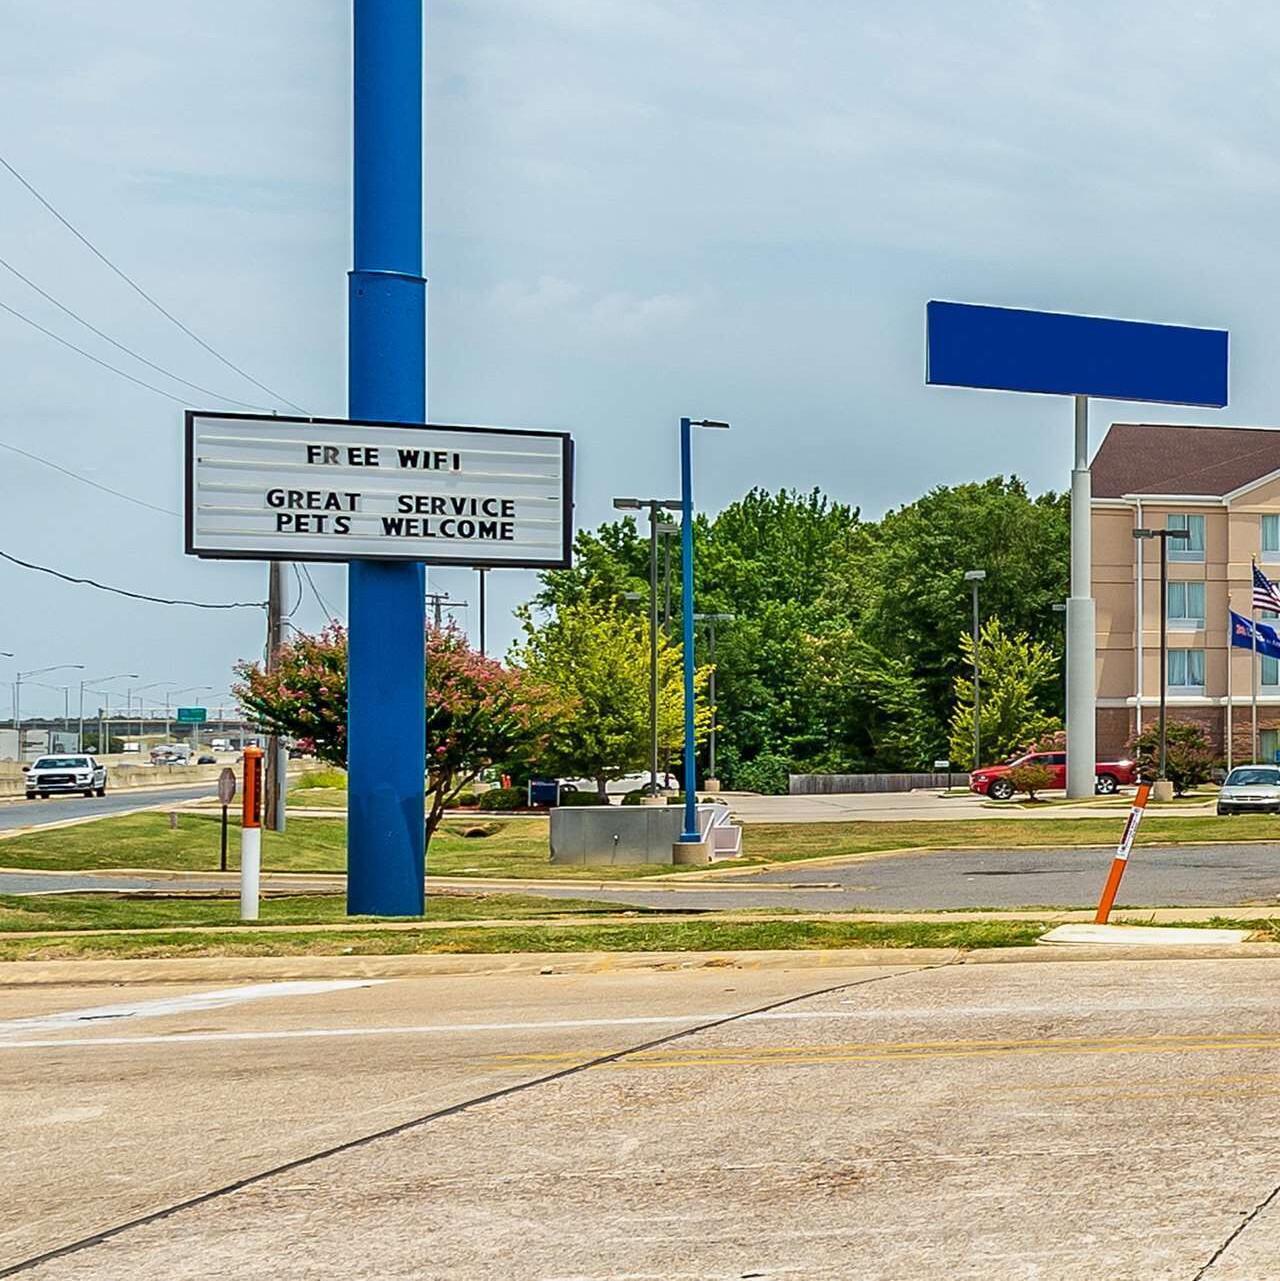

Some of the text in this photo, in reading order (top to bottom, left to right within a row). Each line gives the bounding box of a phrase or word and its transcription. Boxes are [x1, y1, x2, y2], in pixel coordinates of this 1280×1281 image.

[306, 445, 460, 470] FREE WIFI
[266, 489, 515, 518] GREAT SERVICE
[276, 513, 514, 540] PETS WELCOME
